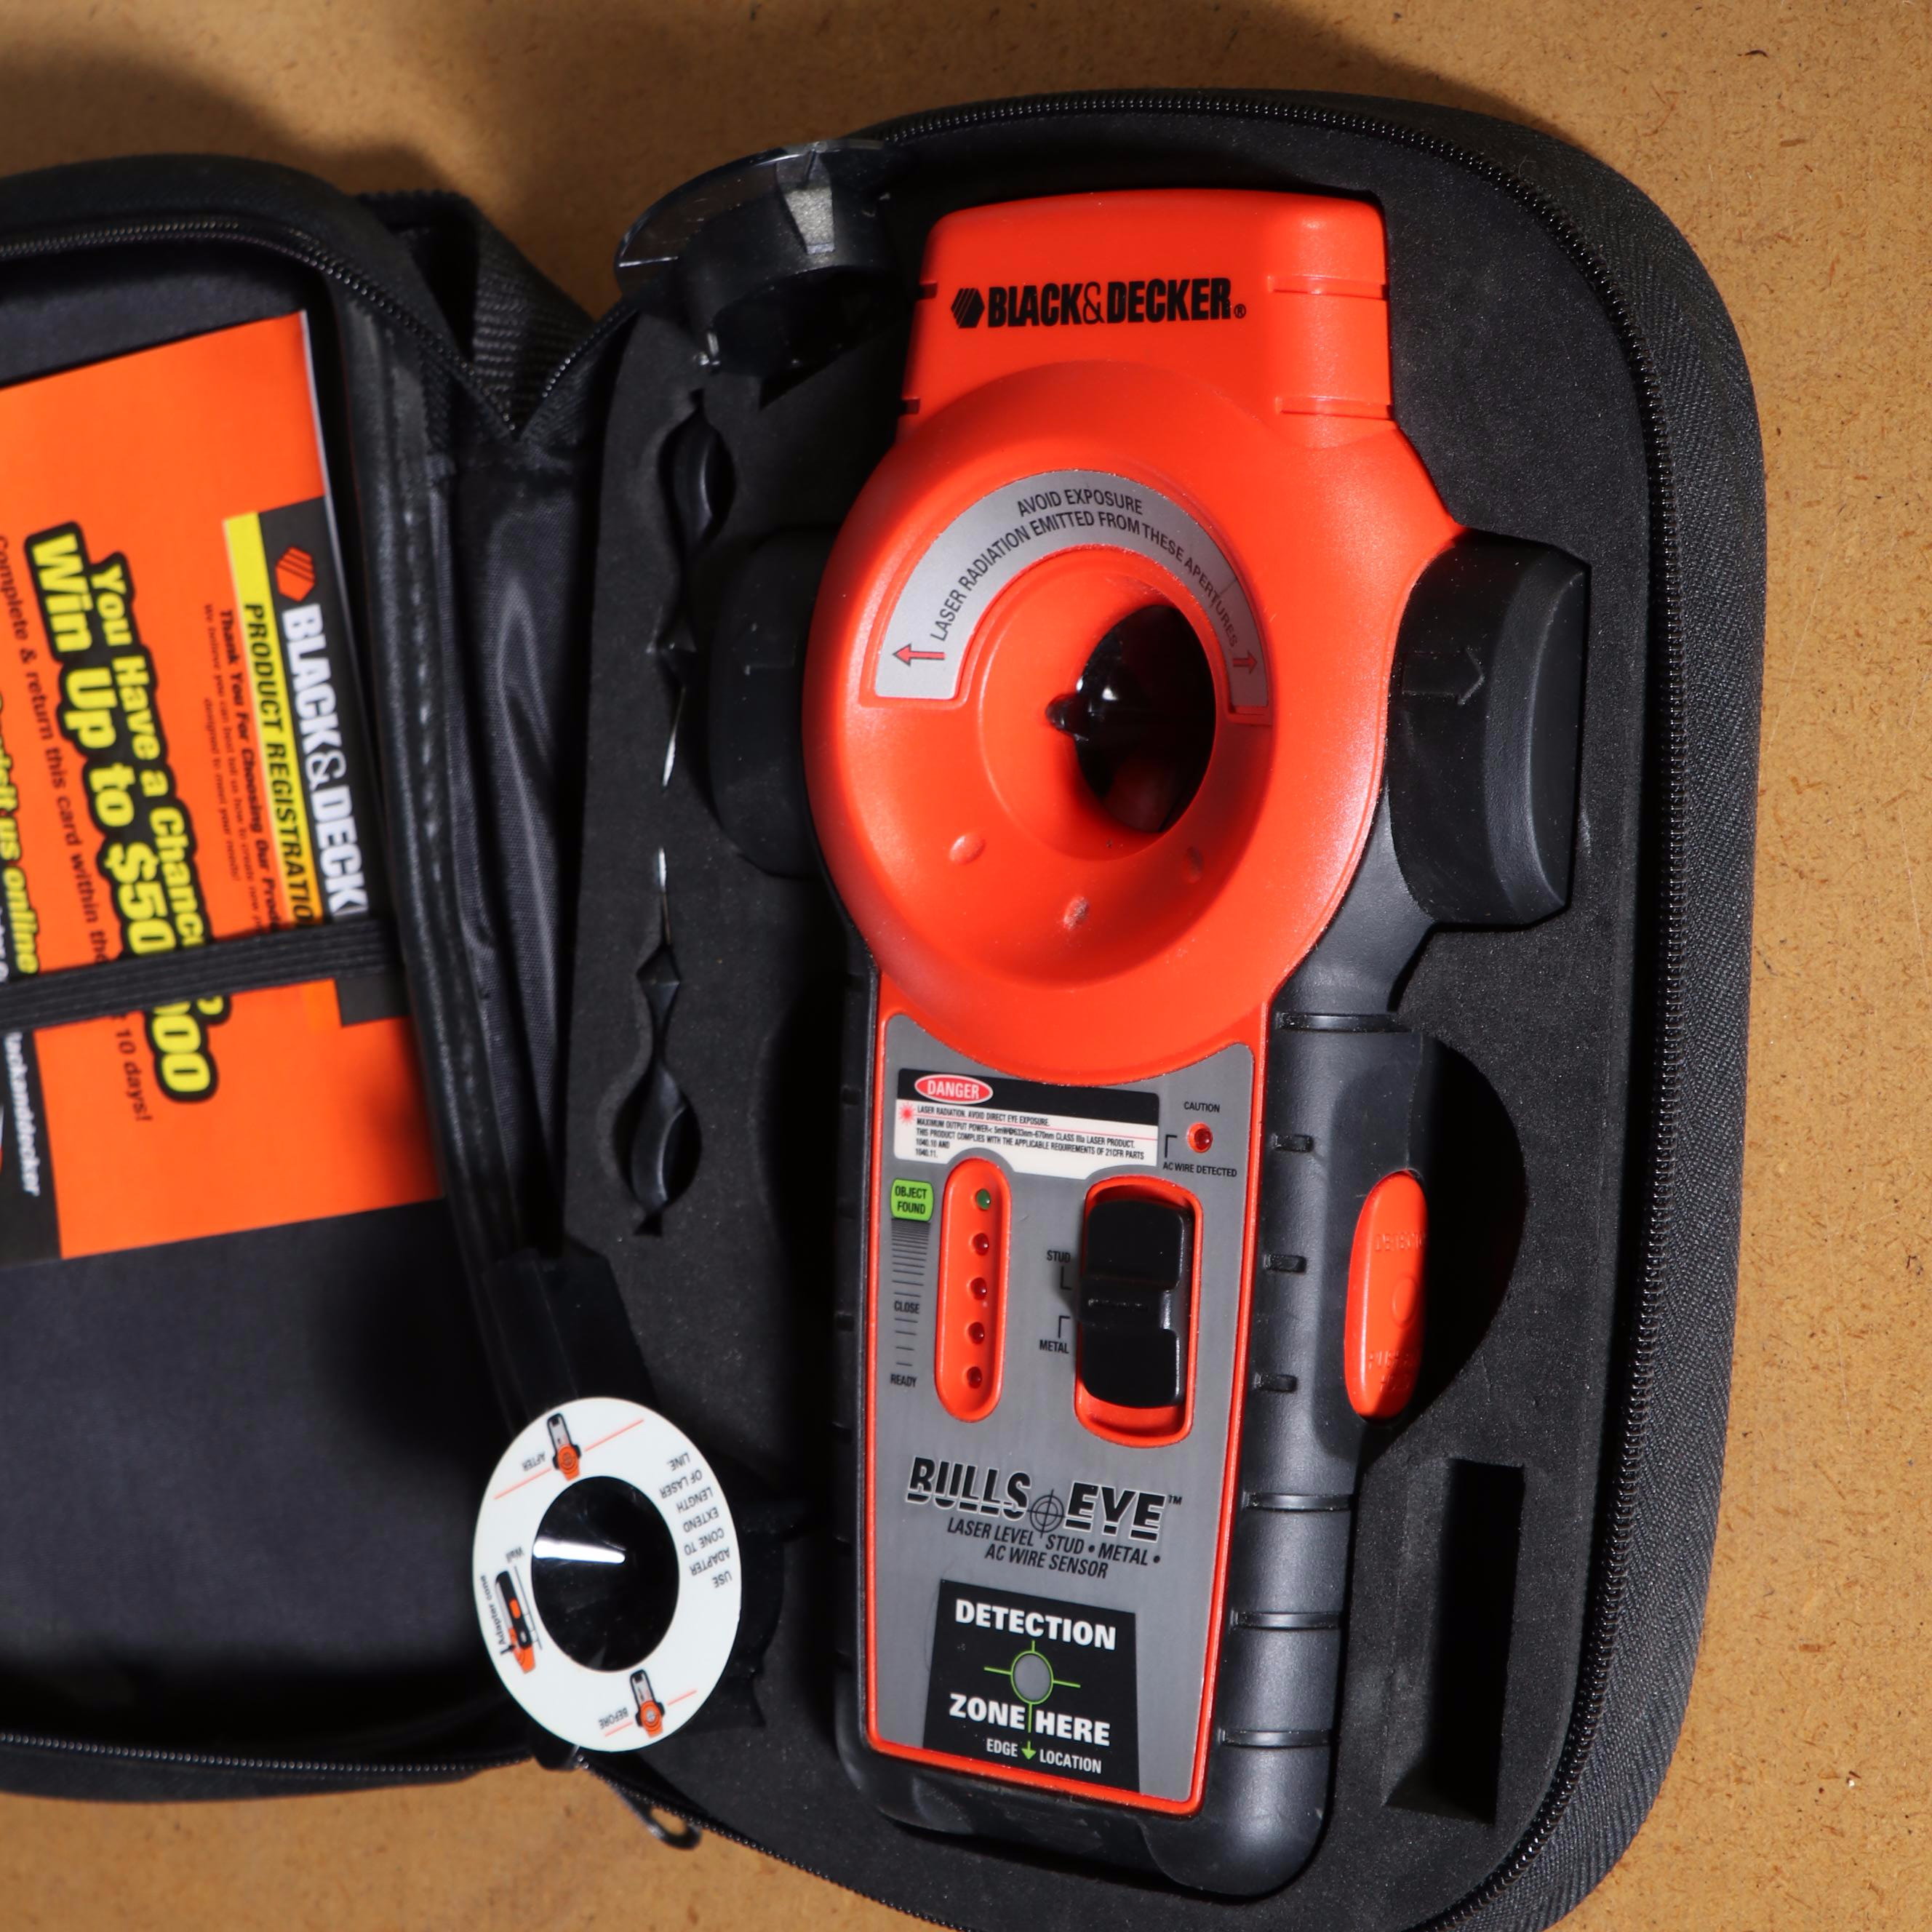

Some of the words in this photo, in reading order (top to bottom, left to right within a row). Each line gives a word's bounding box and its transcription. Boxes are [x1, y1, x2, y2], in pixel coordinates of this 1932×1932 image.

[1018, 491, 1062, 517] AVOID
[1066, 489, 1143, 515] EXPOSURE
[32, 533, 93, 652] Win
[930, 589, 967, 642] LASER
[959, 525, 1031, 592] RADIATION
[1030, 511, 1094, 536] EMITTED
[1099, 511, 1141, 535] FROM
[1142, 523, 1184, 562] THESE
[1184, 557, 1237, 647] APERTURES
[91, 563, 132, 646] You
[221, 609, 239, 665] Thank
[20, 648, 36, 663] &
[231, 673, 244, 706] You
[26, 672, 53, 740] return
[64, 667, 117, 748] Up
[112, 655, 160, 759] Have
[236, 712, 250, 741] For
[45, 747, 66, 789] this
[245, 604, 283, 733] PRODUCT
[266, 743, 314, 925] REGISTRATIO
[282, 604, 369, 916] BLACK&DECK
[89, 762, 135, 827] to
[140, 770, 168, 797] a
[242, 749, 263, 833] Choosing
[57, 797, 82, 845] card
[255, 839, 269, 870] Our
[71, 854, 98, 923] within
[150, 807, 204, 946] Chanc
[3, 867, 39, 973] online
[116, 1028, 135, 1054] 10
[124, 1061, 153, 1121] days!
[927, 1079, 980, 1099] DANGER
[917, 1105, 935, 1114] LASER
[968, 1111, 985, 1119] AVOID
[986, 1113, 1006, 1121] DIRECT
[1020, 1116, 1050, 1126] EXPOSURE.
[1183, 1101, 1221, 1114] CAUTION
[916, 1138, 937, 1148] 1040.10
[938, 1141, 950, 1149] AND
[917, 1118, 945, 1127] MAXIMUM
[946, 1121, 967, 1129] OUTPUT
[1056, 1133, 1074, 1141] CLASS
[1087, 1136, 1105, 1145] LASER
[1106, 1138, 1135, 1149] PRODUCT.
[917, 1127, 929, 1136] THIS
[930, 1129, 955, 1138] PRODUCT
[957, 1132, 985, 1143] COMPLIES
[986, 1135, 1001, 1143] WITH
[1002, 1137, 1013, 1146] THE
[1015, 1138, 1049, 1150] APPLICABLE
[1050, 1143, 1095, 1155] REQUIREMENTS
[1096, 1147, 1104, 1156] OF
[1125, 1150, 1144, 1160] PARTS
[1175, 1162, 1194, 1174] WIRE
[1195, 1165, 1237, 1178] DETECTED
[894, 1185, 927, 1200] OBJECT
[897, 1201, 926, 1215] FOUND
[1047, 1250, 1071, 1264] STUD
[894, 1301, 920, 1314] CLOSE
[1039, 1340, 1069, 1354] METAL
[890, 1373, 917, 1388] READY
[522, 1451, 546, 1472] AFTER
[690, 1469, 703, 1484] OF
[659, 1476, 689, 1499] LASER
[676, 1486, 714, 1513] LENGTH
[906, 1456, 1032, 1521] BULLS
[683, 1506, 719, 1533] EXTEND
[684, 1544, 698, 1556] TO
[699, 1528, 724, 1548] CONE
[946, 1517, 991, 1540] LASER
[994, 1526, 1034, 1548] LEVEL
[1045, 1533, 1085, 1555] STUD
[1098, 1541, 1149, 1566] METAL
[506, 1546, 524, 1563] Wall
[690, 1547, 731, 1576] ADAPTER
[985, 1545, 1007, 1562] AC
[1008, 1549, 1046, 1569] WIRE
[1049, 1555, 1109, 1579] SENSOR
[711, 1570, 733, 1589] USE
[488, 1603, 506, 1645] Adapter
[955, 1598, 1116, 1650] DETECTION
[599, 1707, 628, 1730] BEFORE
[949, 1693, 1026, 1730] ZONE
[1035, 1709, 1111, 1747] HERE
[986, 1739, 1018, 1757] EDGE
[1039, 1749, 1102, 1773] LOCATION
